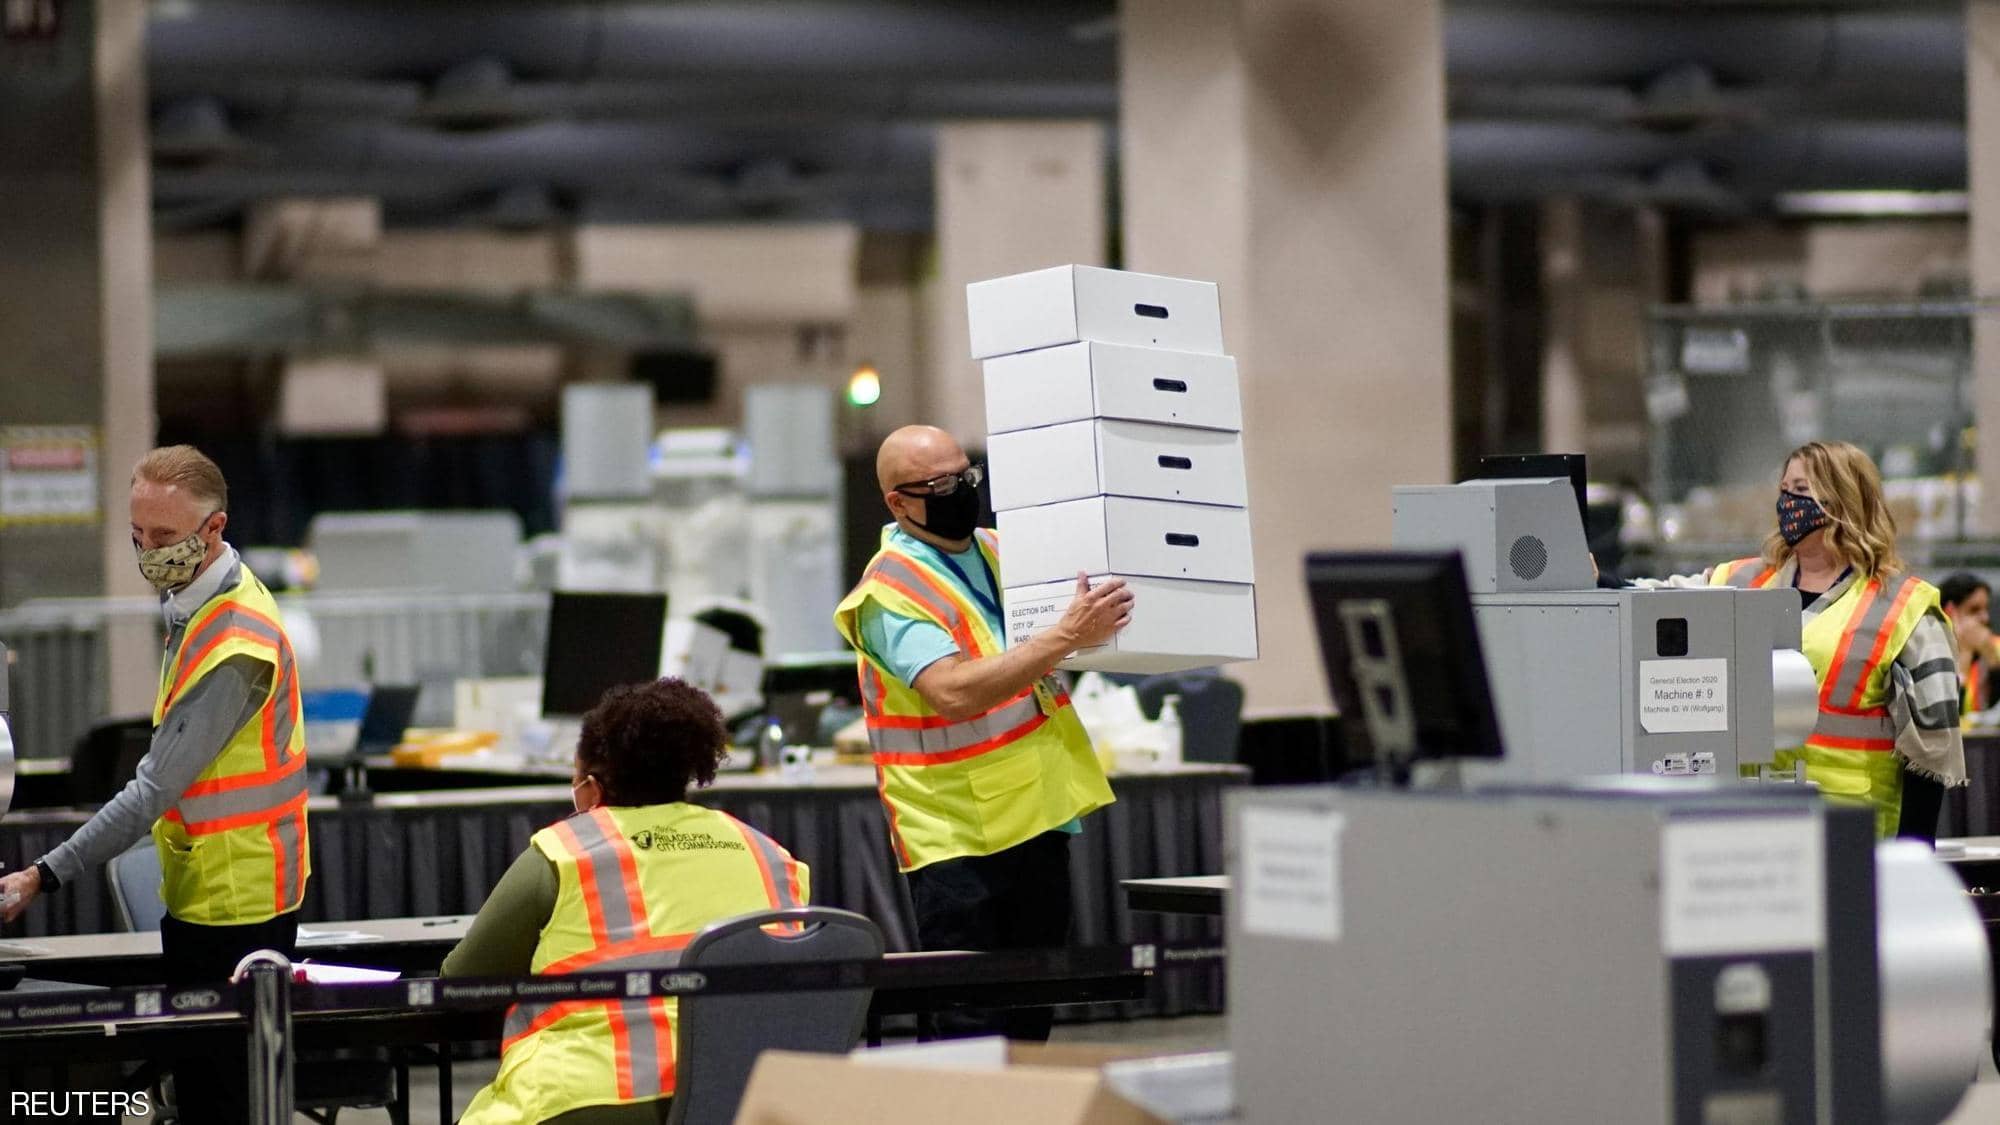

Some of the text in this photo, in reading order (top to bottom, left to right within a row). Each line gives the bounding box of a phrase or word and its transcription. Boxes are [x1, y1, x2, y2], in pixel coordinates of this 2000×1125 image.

[1012, 604, 1055, 618] ELECTION DATE
[1013, 621, 1034, 631] CITY OF
[1649, 675, 1718, 685] General Election 2020
[1654, 689, 1694, 700] Machine
[1707, 688, 1714, 699] 9
[1644, 705, 1670, 713] Machine
[1682, 705, 1689, 713] W
[654, 832, 712, 843] PHILADELPHIA
[656, 841, 676, 852] CITY
[516, 982, 576, 995] Convention
[580, 979, 617, 992] Center
[18, 1004, 82, 1019] Convention
[85, 1001, 125, 1014] Center
